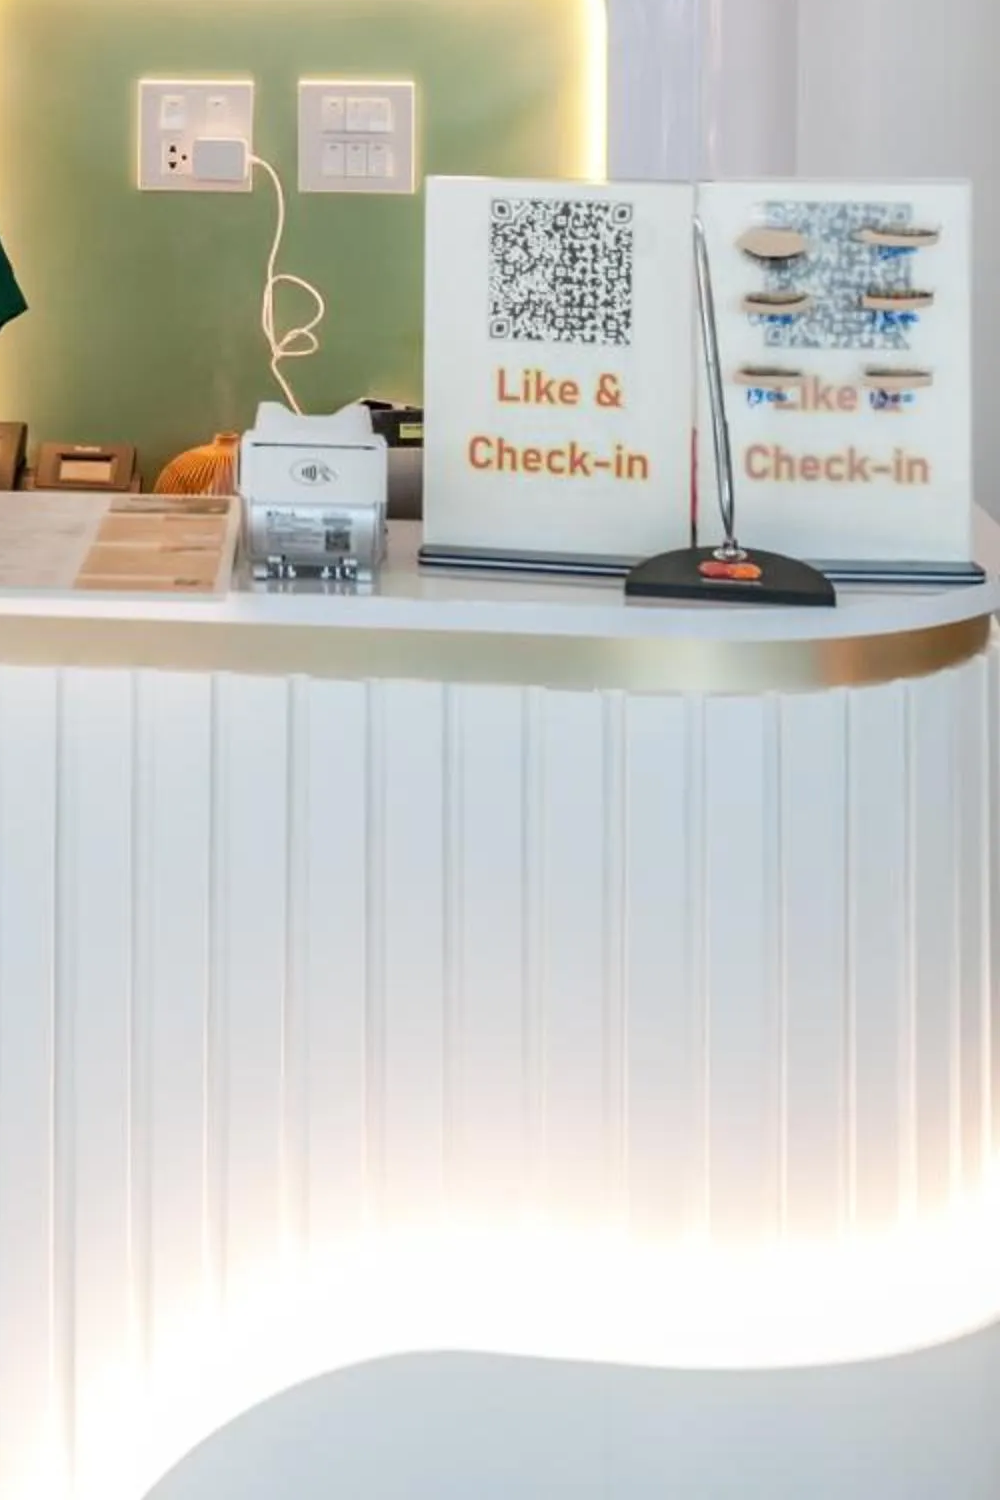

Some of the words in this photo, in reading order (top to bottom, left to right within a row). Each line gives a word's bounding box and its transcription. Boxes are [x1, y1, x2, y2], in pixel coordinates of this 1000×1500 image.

[496, 368, 580, 405] Like
[595, 372, 624, 408] &
[468, 435, 649, 480] Check-in
[743, 443, 931, 485] Check-in
